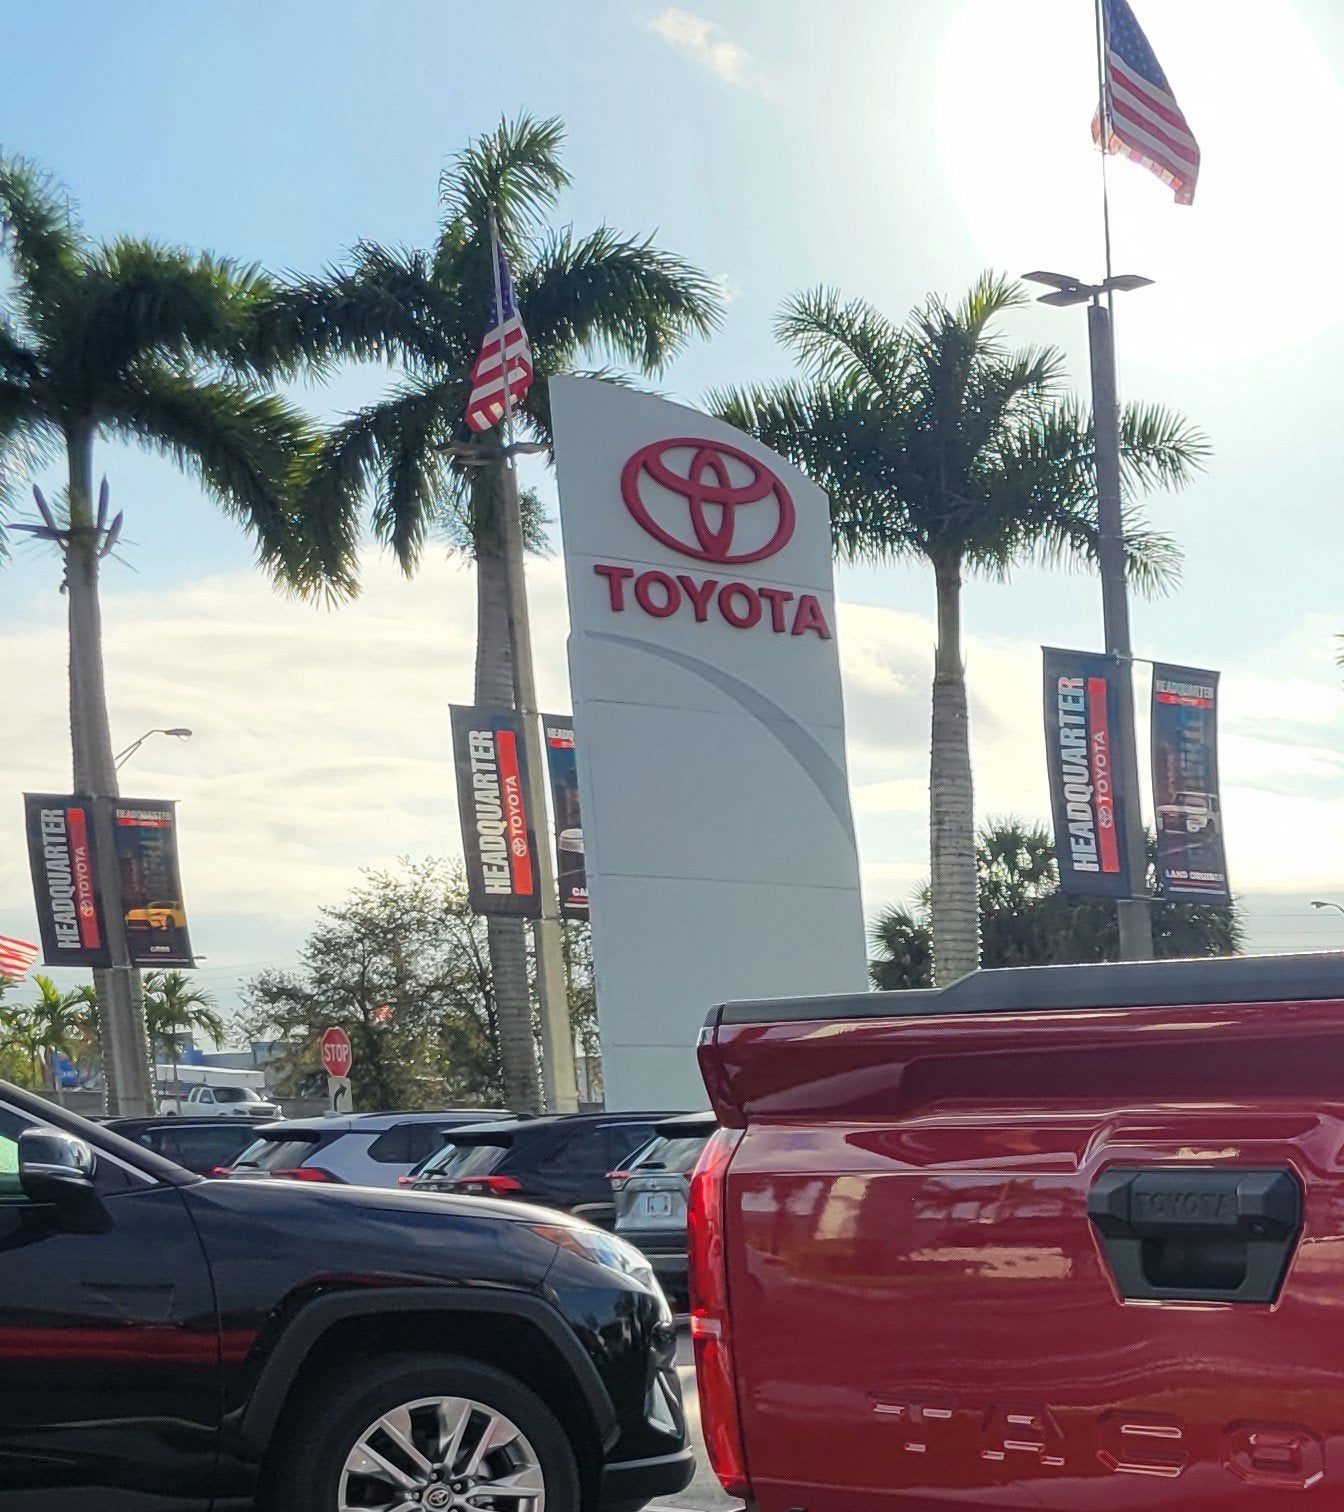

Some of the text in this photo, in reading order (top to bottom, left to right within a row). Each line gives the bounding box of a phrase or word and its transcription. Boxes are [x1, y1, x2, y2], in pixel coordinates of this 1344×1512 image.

[594, 564, 832, 640] TOYOTA
[1058, 676, 1100, 872] HEADQUARTER
[1094, 731, 1110, 803] TOYOTA
[468, 730, 512, 894] HEADQUARTER
[506, 775, 523, 836] TOYOTA
[41, 809, 81, 949] HEADQUARTER
[75, 847, 90, 899] TOYOTA
[324, 1043, 349, 1061] STOP
